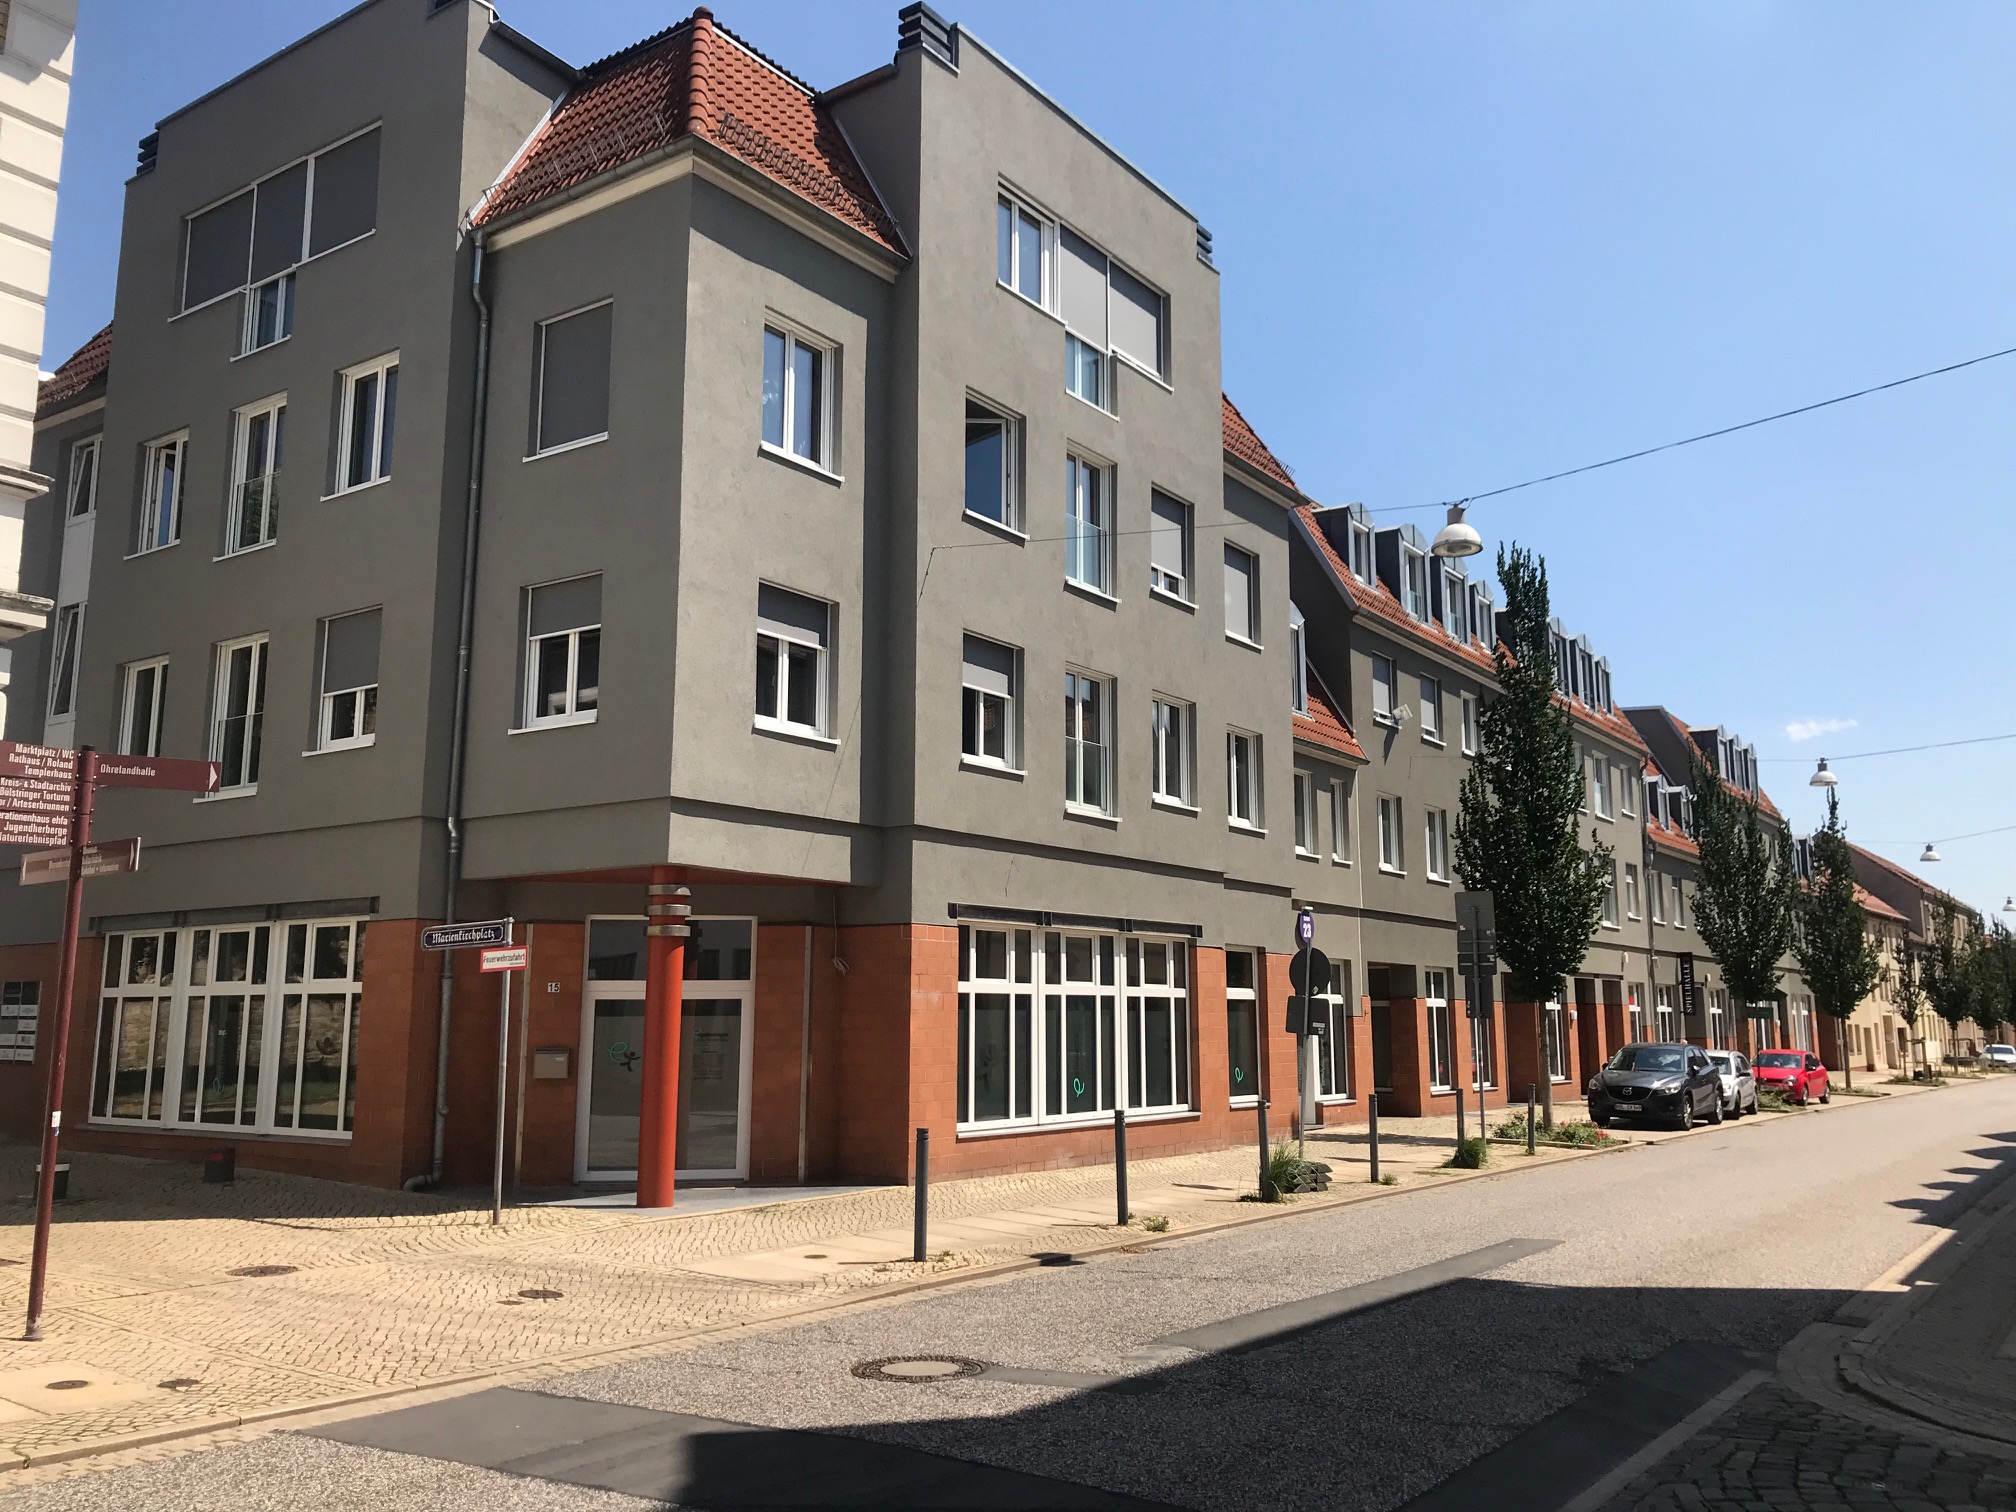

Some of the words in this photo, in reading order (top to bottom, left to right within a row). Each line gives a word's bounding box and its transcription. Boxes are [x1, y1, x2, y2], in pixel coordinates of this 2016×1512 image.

[15, 743, 56, 758] Marktplatz
[62, 749, 75, 760] WC
[9, 753, 41, 766] Rathaus
[46, 758, 74, 769] Roland
[24, 765, 73, 779] Templerhaus
[100, 763, 156, 777] Ohrelandhalle
[0, 777, 23, 787] Kreis-
[23, 780, 29, 788] &
[29, 779, 72, 792] Stadtarchiv
[0, 786, 42, 801] Bülstringer
[42, 790, 71, 802] Torturm
[12, 799, 70, 812] Arteserbrunnen
[4, 821, 68, 837] Jugendherberge
[432, 928, 495, 944] Marienkirchplatz
[548, 983, 560, 992] 15
[1683, 962, 1693, 1013] SPIELHALLE
